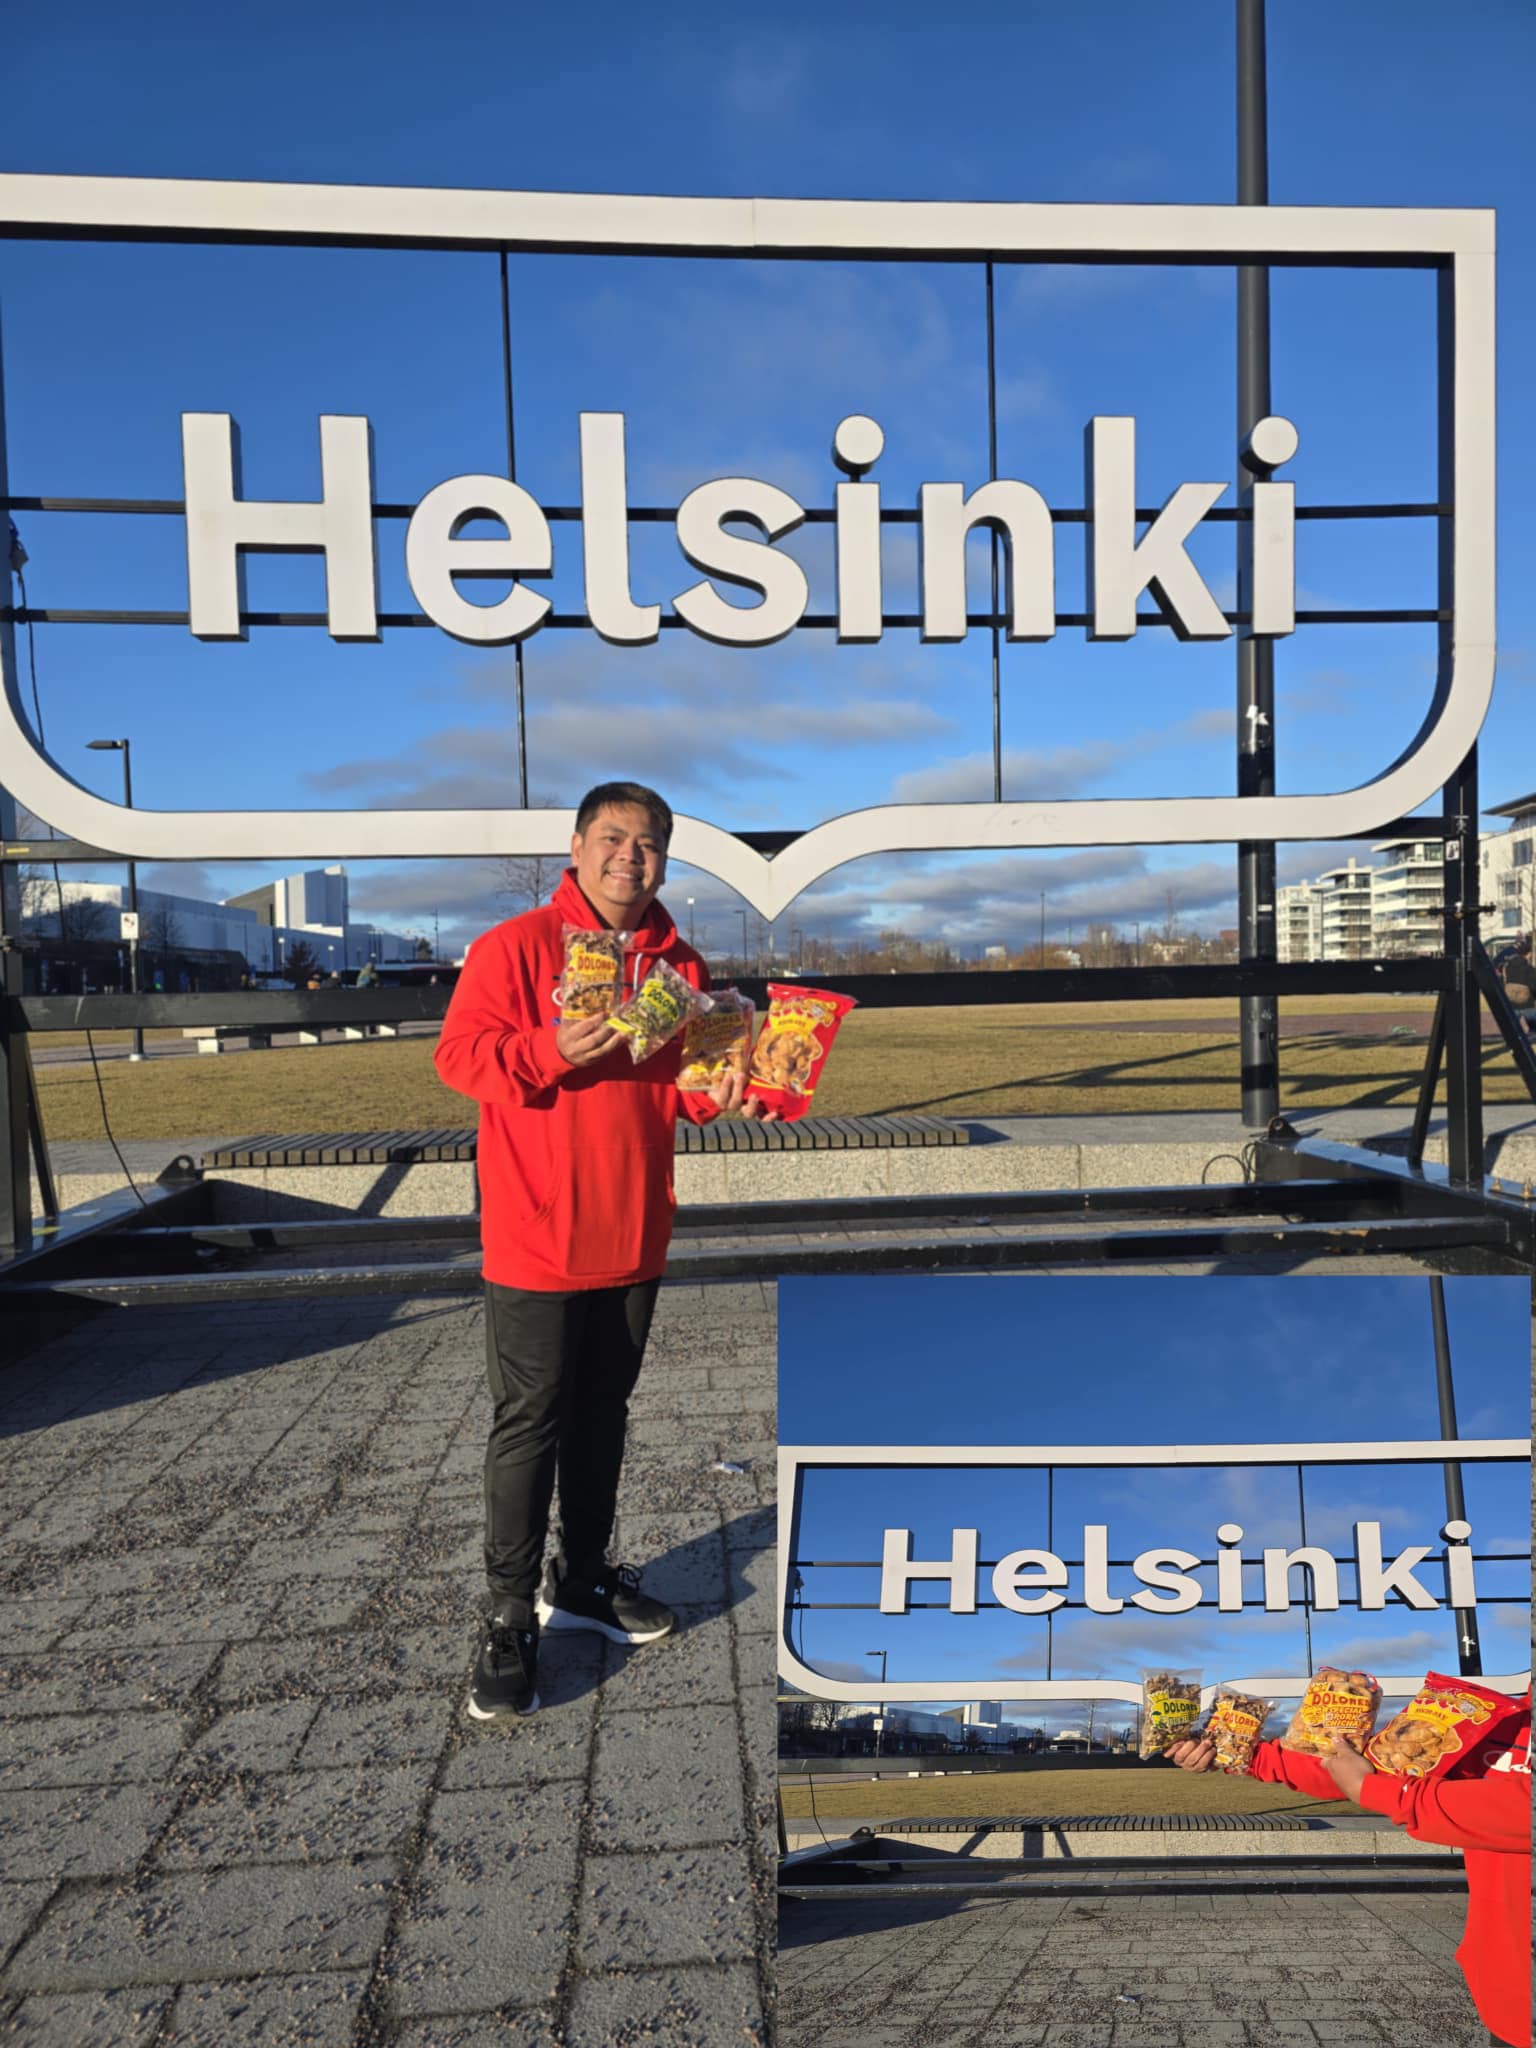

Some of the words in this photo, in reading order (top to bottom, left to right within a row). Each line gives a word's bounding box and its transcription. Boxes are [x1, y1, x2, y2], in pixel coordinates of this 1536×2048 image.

[181, 411, 1299, 646] Helsinki
[879, 1520, 1477, 1615] Helsinki
[1311, 1692, 1371, 1707] DOLORES
